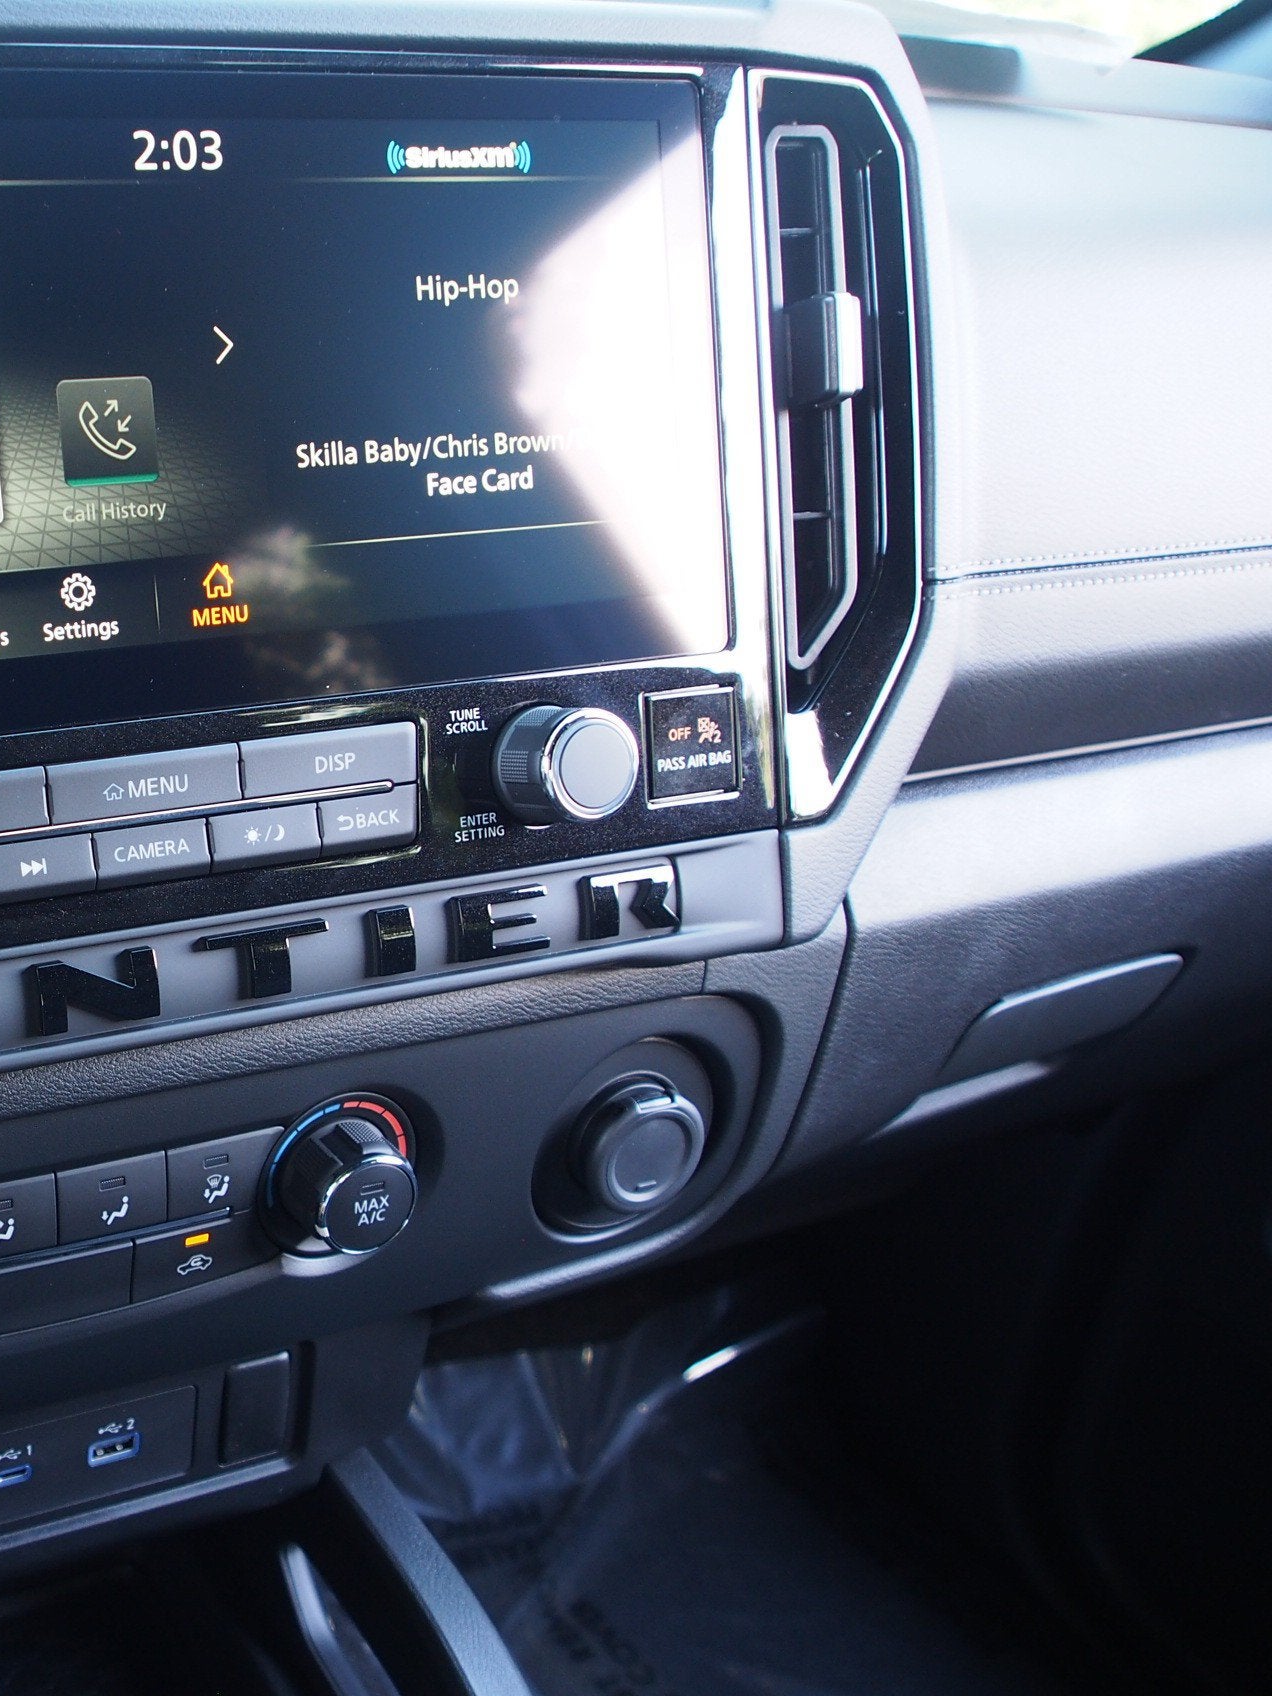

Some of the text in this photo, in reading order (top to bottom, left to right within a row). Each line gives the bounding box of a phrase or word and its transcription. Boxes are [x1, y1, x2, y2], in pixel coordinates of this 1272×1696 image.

[131, 129, 224, 172] 2:03
[415, 274, 520, 306] Hip-Hop
[296, 440, 358, 469] Skilla
[364, 432, 489, 468] Baby/Chris
[426, 466, 535, 498] Face Card
[62, 499, 167, 525] Call History
[191, 603, 250, 628] MENU
[42, 613, 121, 645] Settings
[449, 707, 481, 722] TUNE
[445, 720, 488, 735] SCROLL
[668, 727, 692, 742] OFF
[313, 751, 357, 776] DISP
[657, 750, 732, 773] PASS AIR BAG
[127, 773, 190, 799] MENU
[355, 806, 400, 830] BACK
[459, 812, 498, 828] ENTER
[454, 825, 505, 843] SETTING
[113, 837, 191, 864] CAMERA
[354, 1194, 390, 1216] MAX
[357, 1206, 387, 1227] A/C
[126, 1417, 136, 1431] 2
